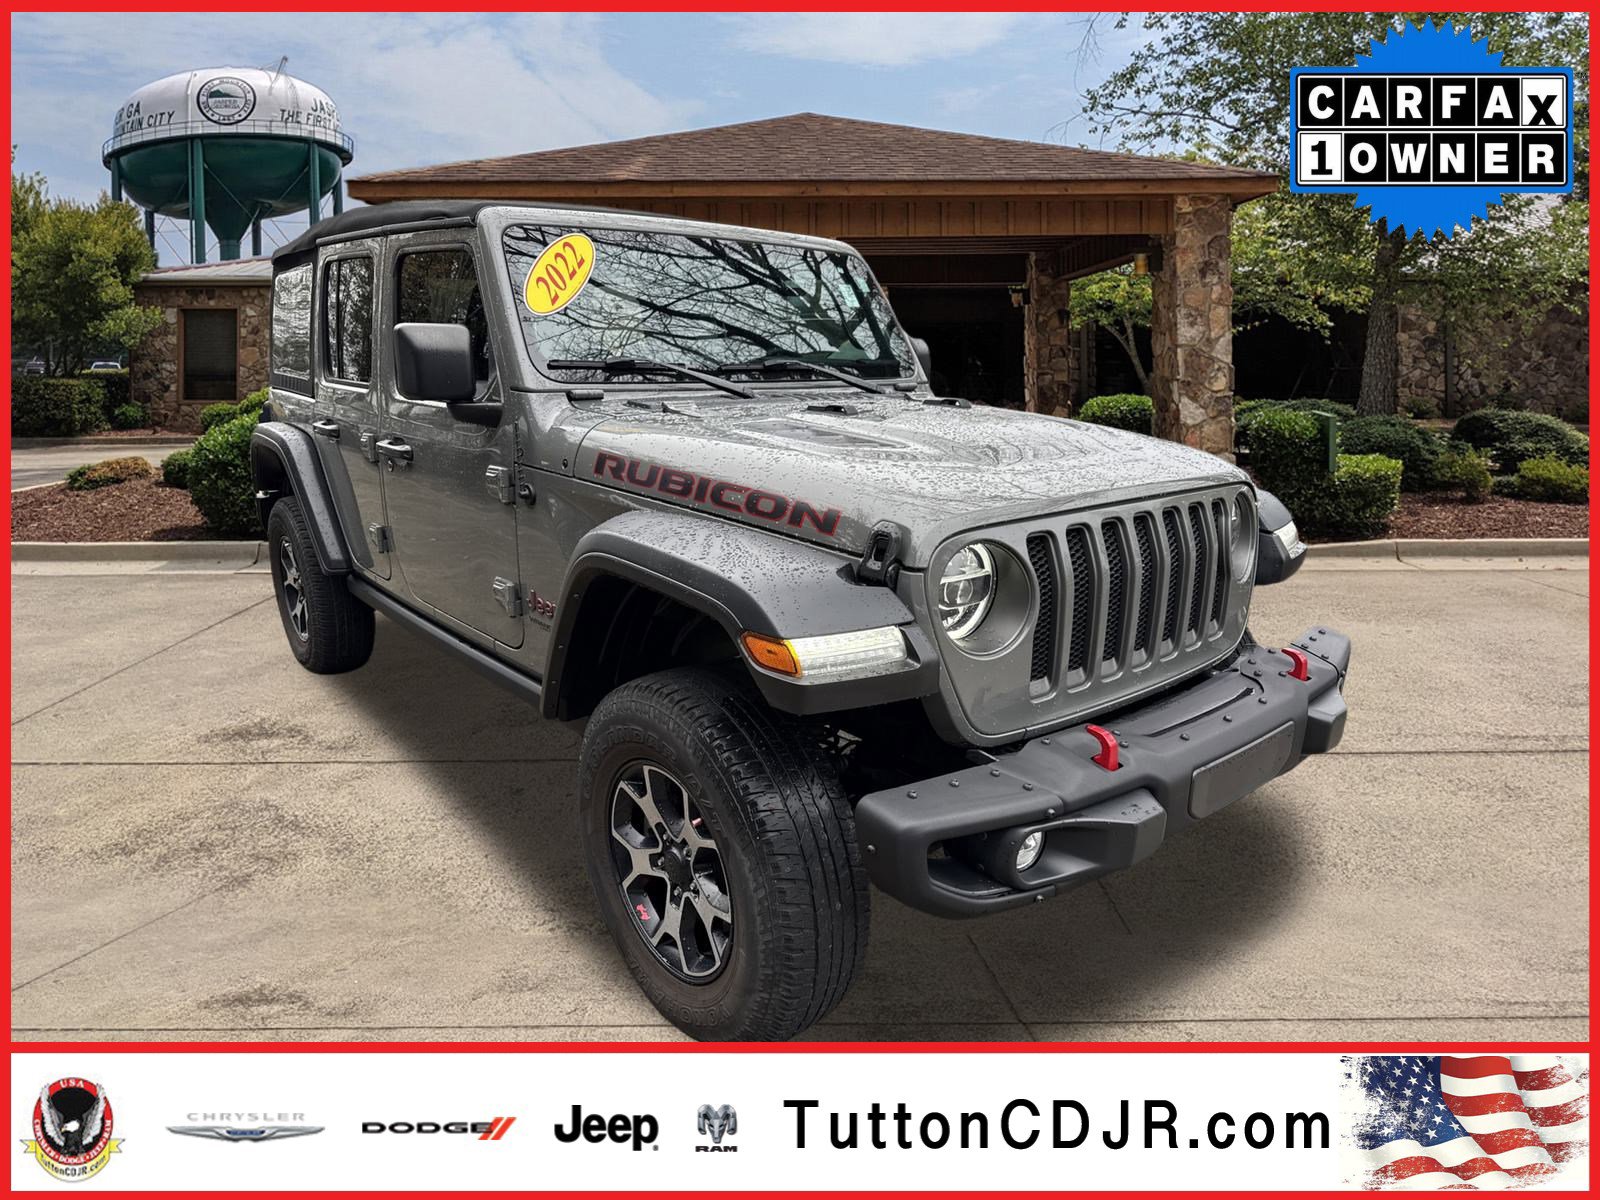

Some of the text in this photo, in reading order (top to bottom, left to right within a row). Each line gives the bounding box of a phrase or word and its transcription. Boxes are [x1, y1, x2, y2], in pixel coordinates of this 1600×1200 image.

[126, 101, 140, 119] GA
[147, 110, 175, 127] CITY
[280, 108, 302, 123] THE
[592, 451, 842, 537] RUBICON
